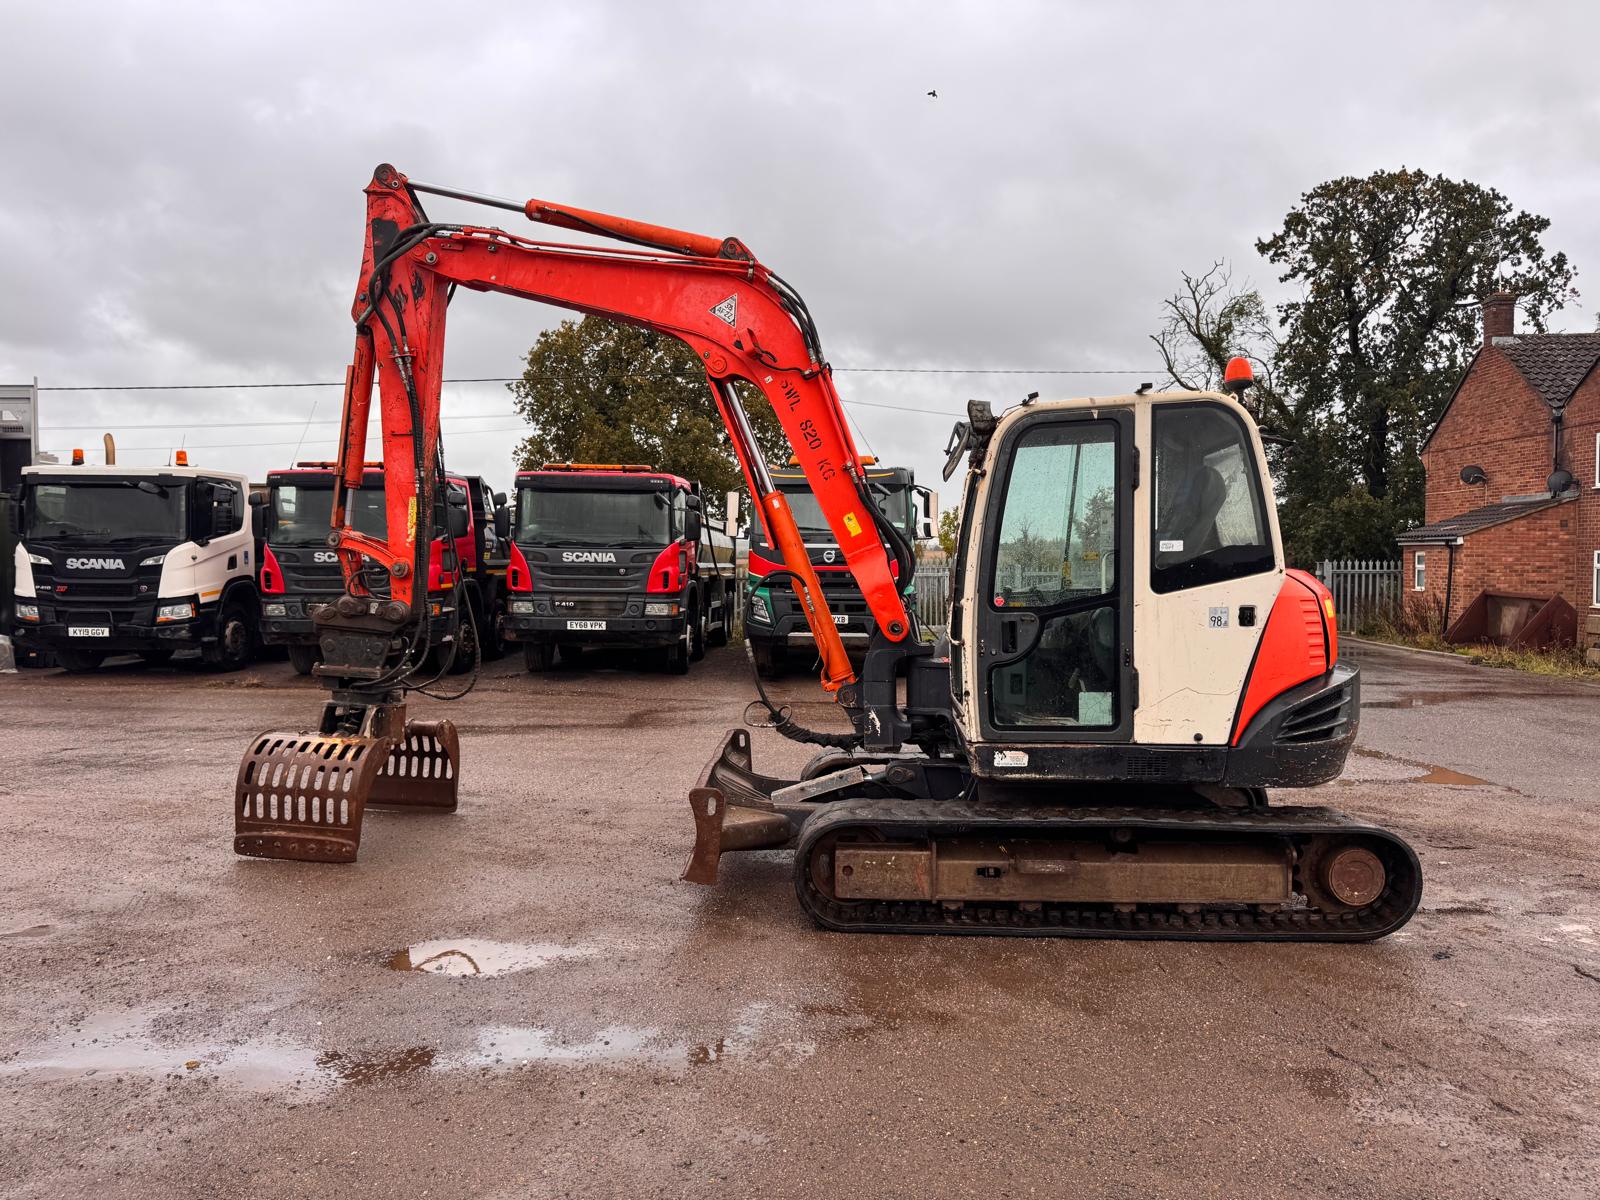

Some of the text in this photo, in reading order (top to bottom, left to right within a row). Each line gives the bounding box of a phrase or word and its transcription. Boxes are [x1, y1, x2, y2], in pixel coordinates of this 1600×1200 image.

[799, 419, 823, 450] 820
[817, 459, 836, 481] KG
[562, 552, 617, 563] SCANIA
[65, 558, 126, 570] SCANIA
[589, 621, 604, 629] VPK
[1210, 615, 1222, 627] 98
